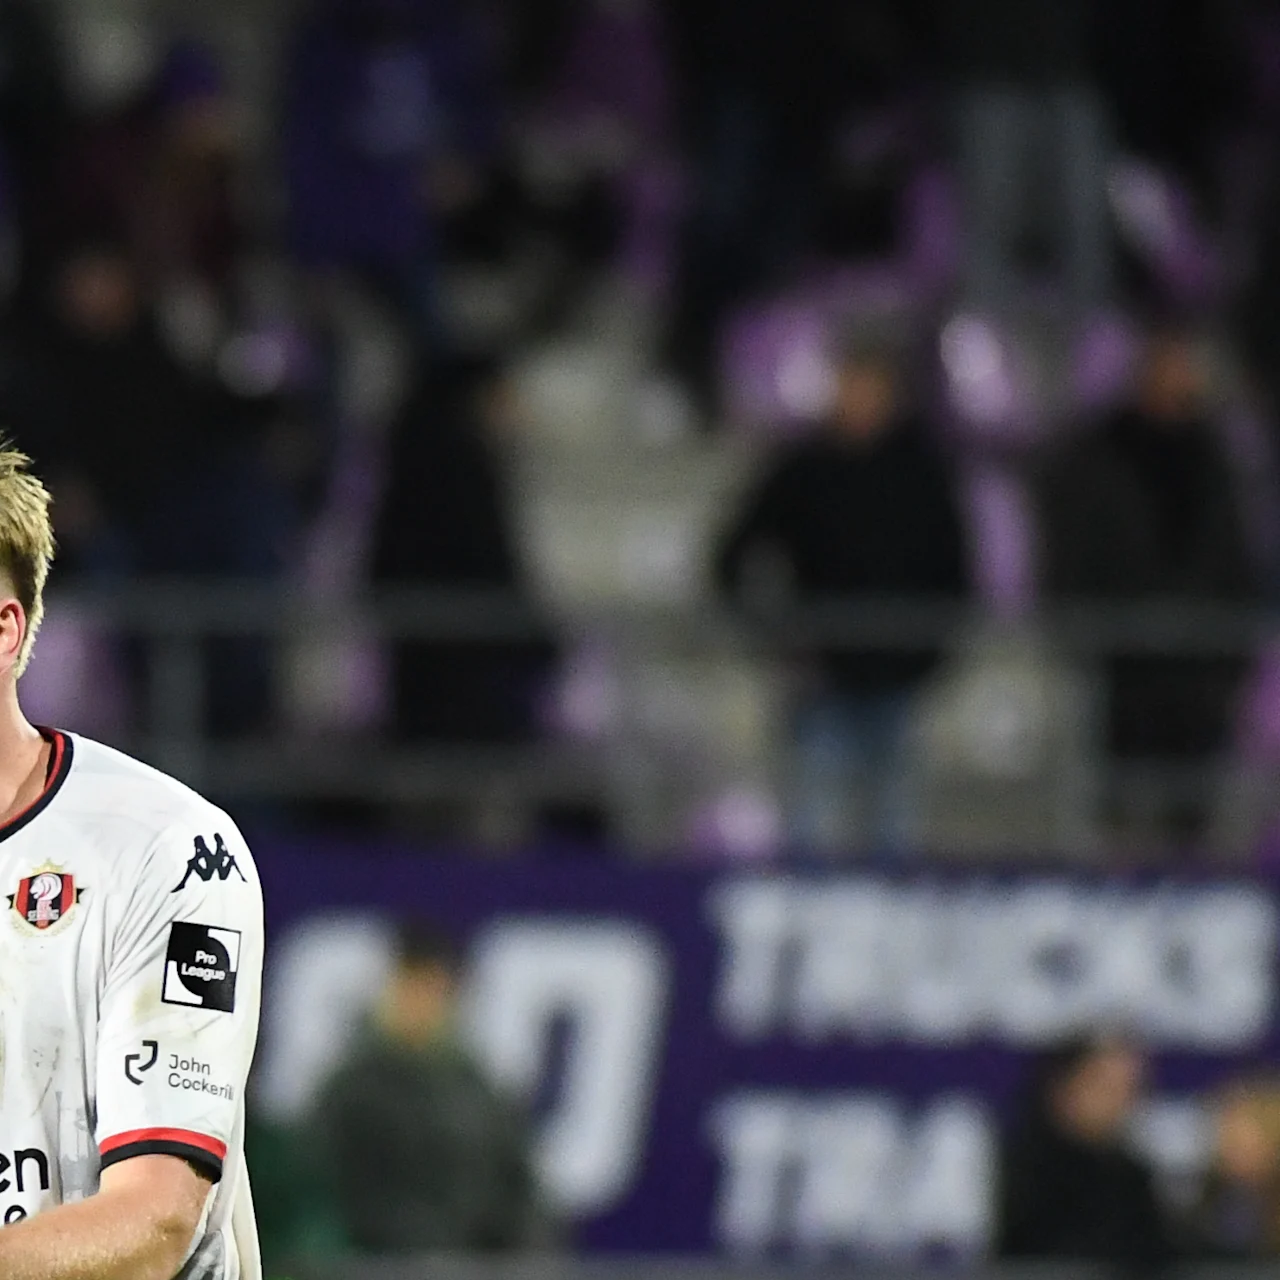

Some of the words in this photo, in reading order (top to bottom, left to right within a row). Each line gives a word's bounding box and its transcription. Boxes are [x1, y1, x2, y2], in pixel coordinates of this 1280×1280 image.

[196, 951, 216, 964] Pro
[181, 963, 225, 981] League
[169, 1054, 210, 1075] John
